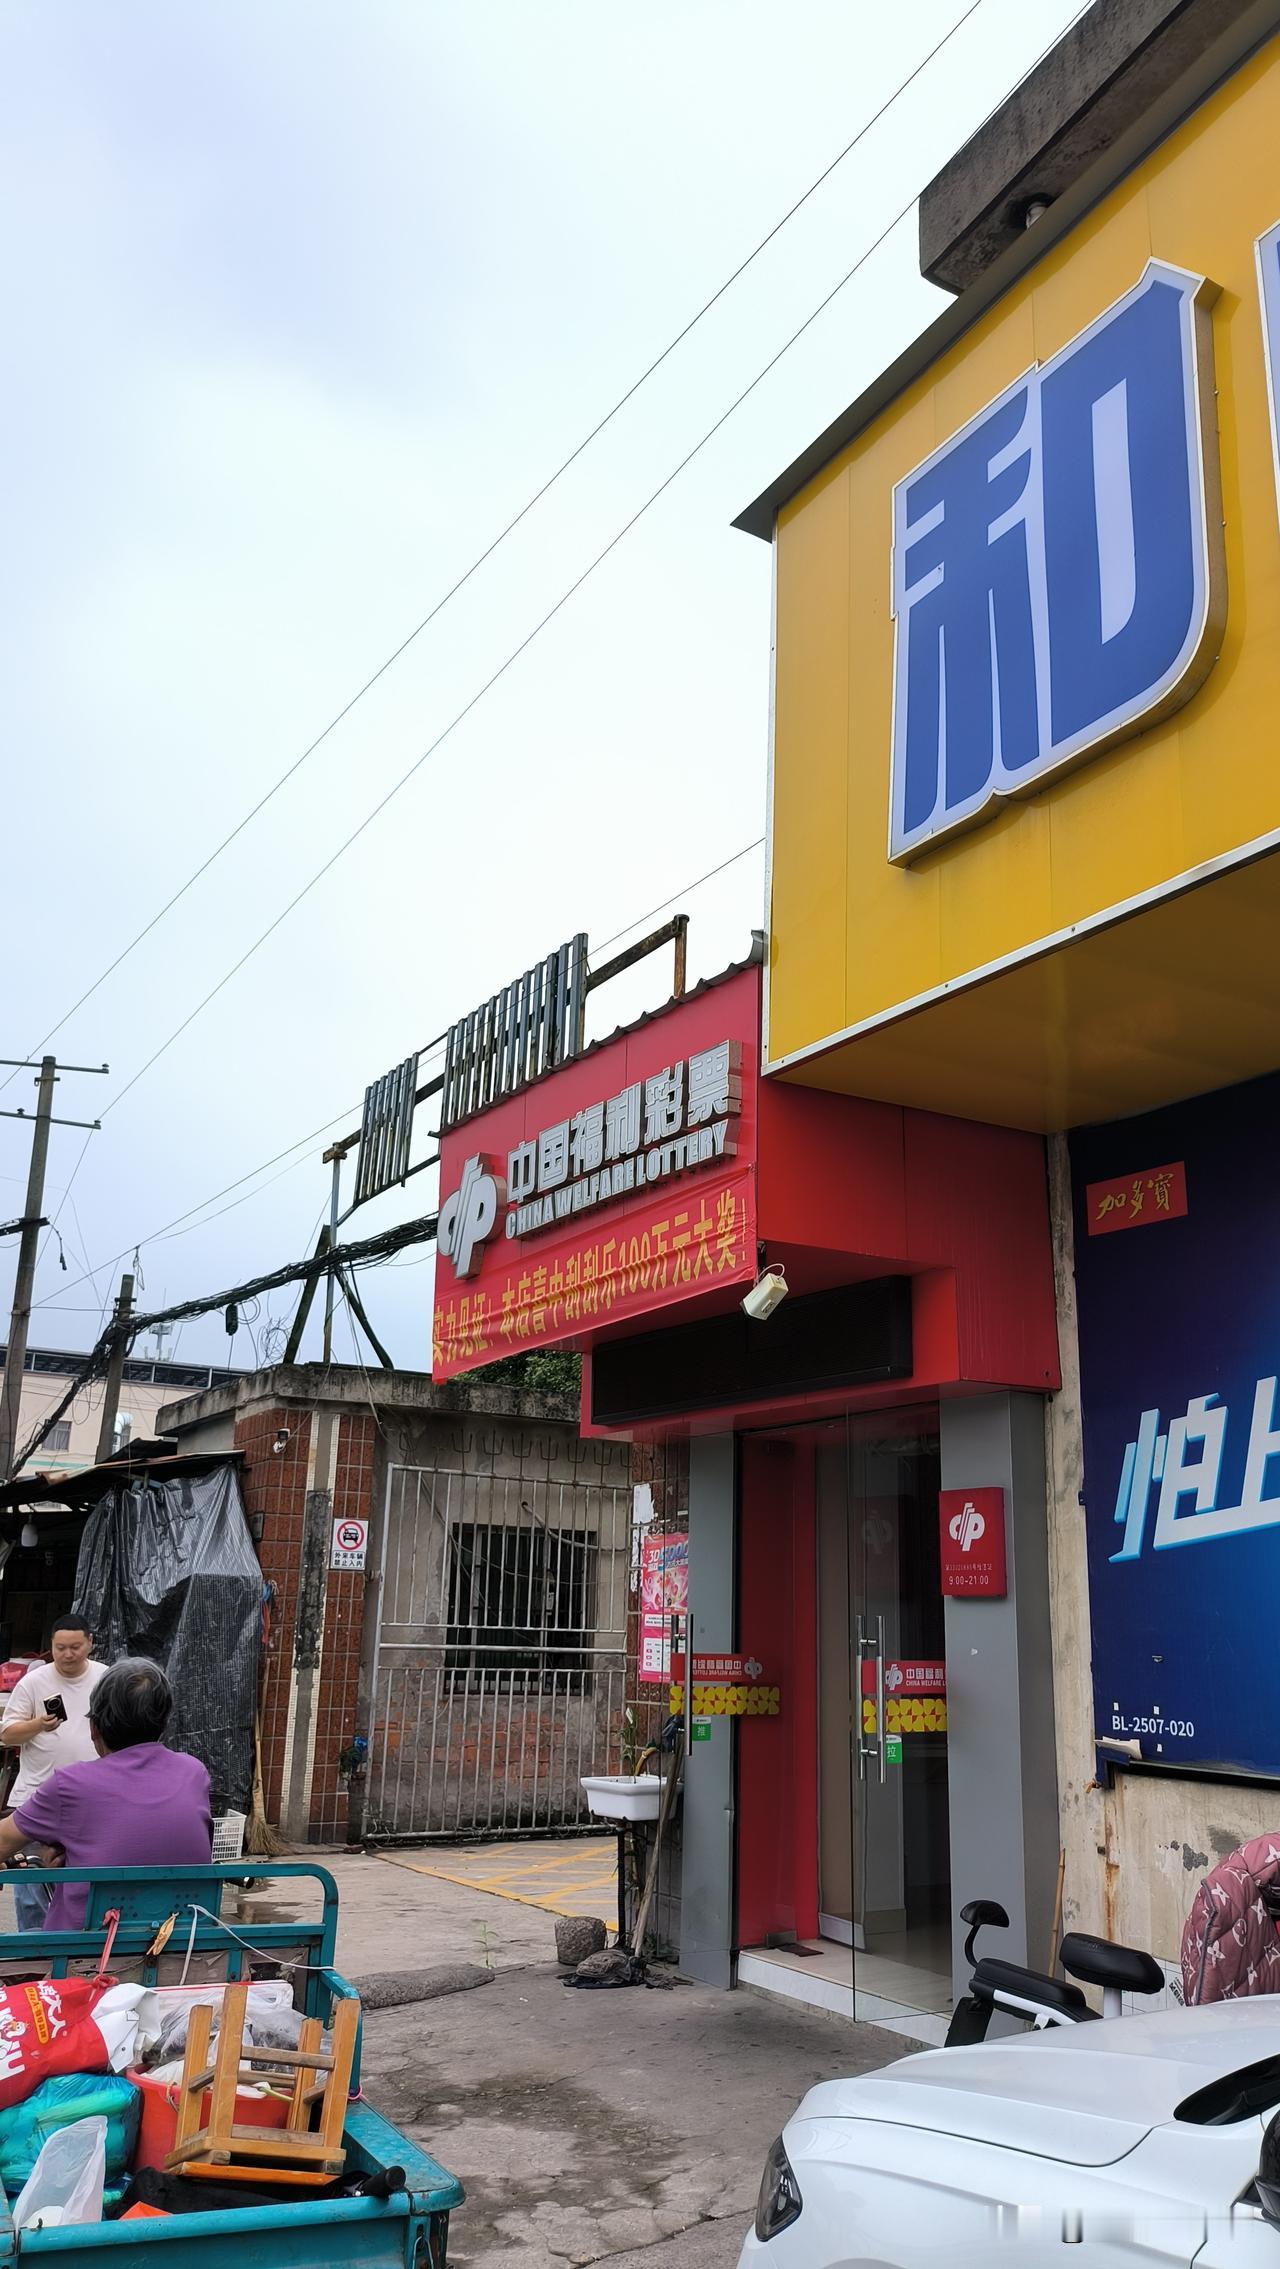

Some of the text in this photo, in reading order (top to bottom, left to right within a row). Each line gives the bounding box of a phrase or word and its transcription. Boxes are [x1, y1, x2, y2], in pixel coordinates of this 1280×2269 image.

[890, 250, 1280, 866] 和
[507, 1041, 734, 1203] 中国福利彩票
[505, 1119, 731, 1240] CHINA WELFARE LOTTERY
[334, 1552, 363, 1560] 外来车辆
[334, 1559, 363, 1567] 禁止入内
[1112, 1715, 1195, 1737] BL-2507-020
